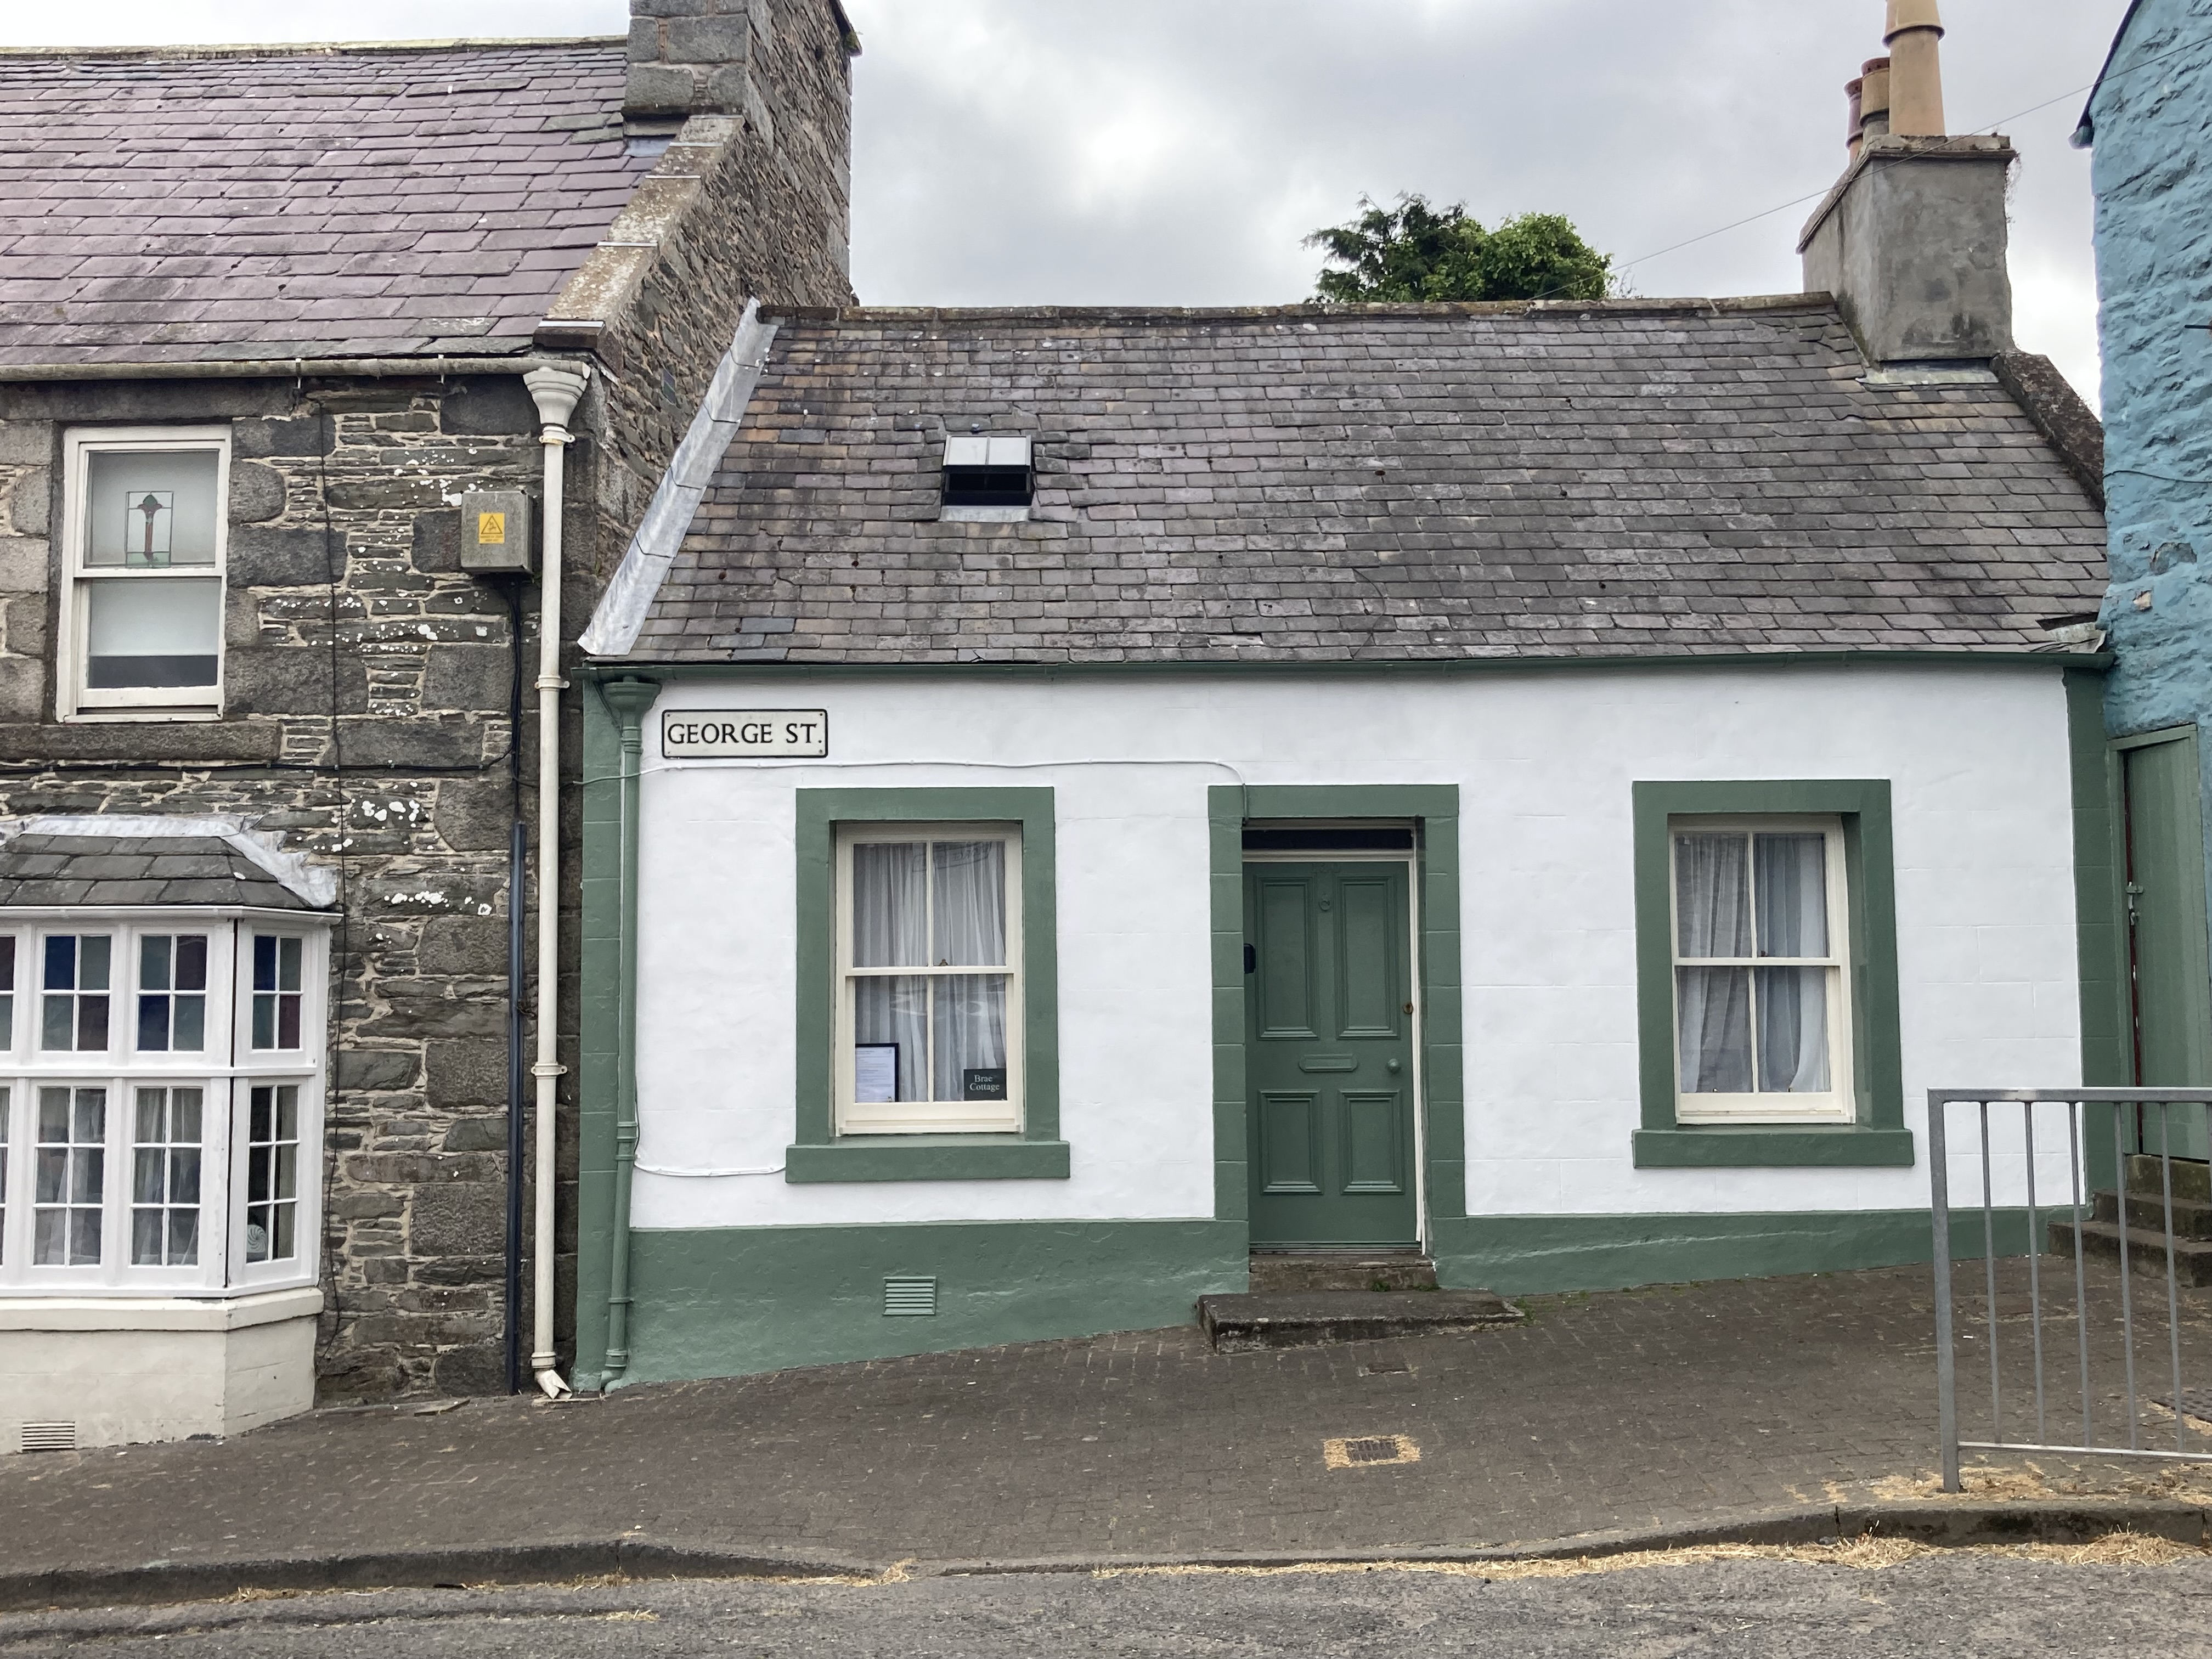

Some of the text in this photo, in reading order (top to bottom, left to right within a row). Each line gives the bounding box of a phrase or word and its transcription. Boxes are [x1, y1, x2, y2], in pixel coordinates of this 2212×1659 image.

[667, 723, 822, 743] GEORGE ST.
[969, 1082, 1000, 1092] Cottage
